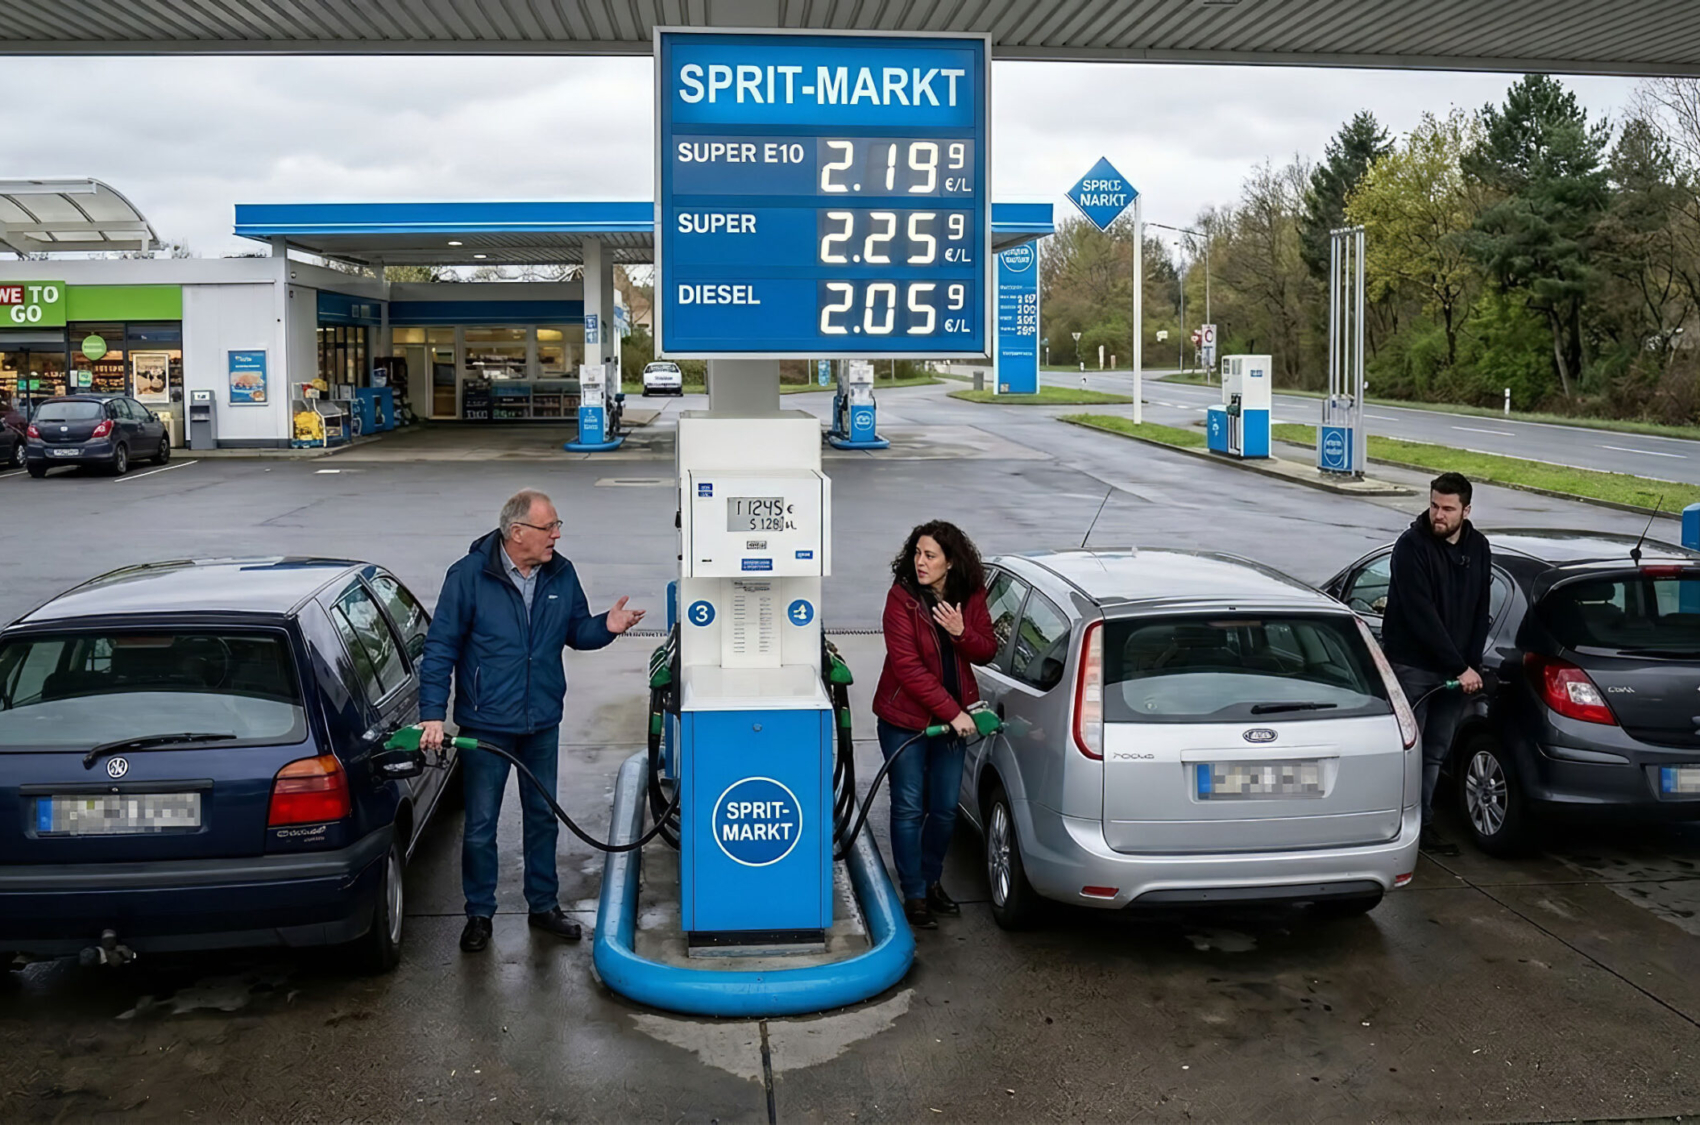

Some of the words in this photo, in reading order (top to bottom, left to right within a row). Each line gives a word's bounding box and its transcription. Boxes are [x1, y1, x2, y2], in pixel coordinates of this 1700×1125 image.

[679, 63, 966, 107] SPRIT-MARKT
[678, 142, 757, 163] SUPER
[764, 143, 805, 163] E10
[820, 141, 939, 193] 2.19
[948, 143, 965, 169] 9
[944, 177, 972, 192] €/L
[678, 213, 757, 234] SUPER
[820, 212, 937, 264] 2.25
[948, 213, 965, 240] 9
[944, 247, 972, 262] €/L
[28, 285, 59, 304] TO
[10, 304, 42, 323] GO
[678, 284, 761, 305] DIESEL
[820, 283, 937, 334] 2.05
[947, 284, 965, 310] 9
[944, 318, 971, 333] €/L
[695, 604, 709, 622] 3
[726, 801, 790, 820] SPRIT-
[722, 823, 794, 841] MARKT
